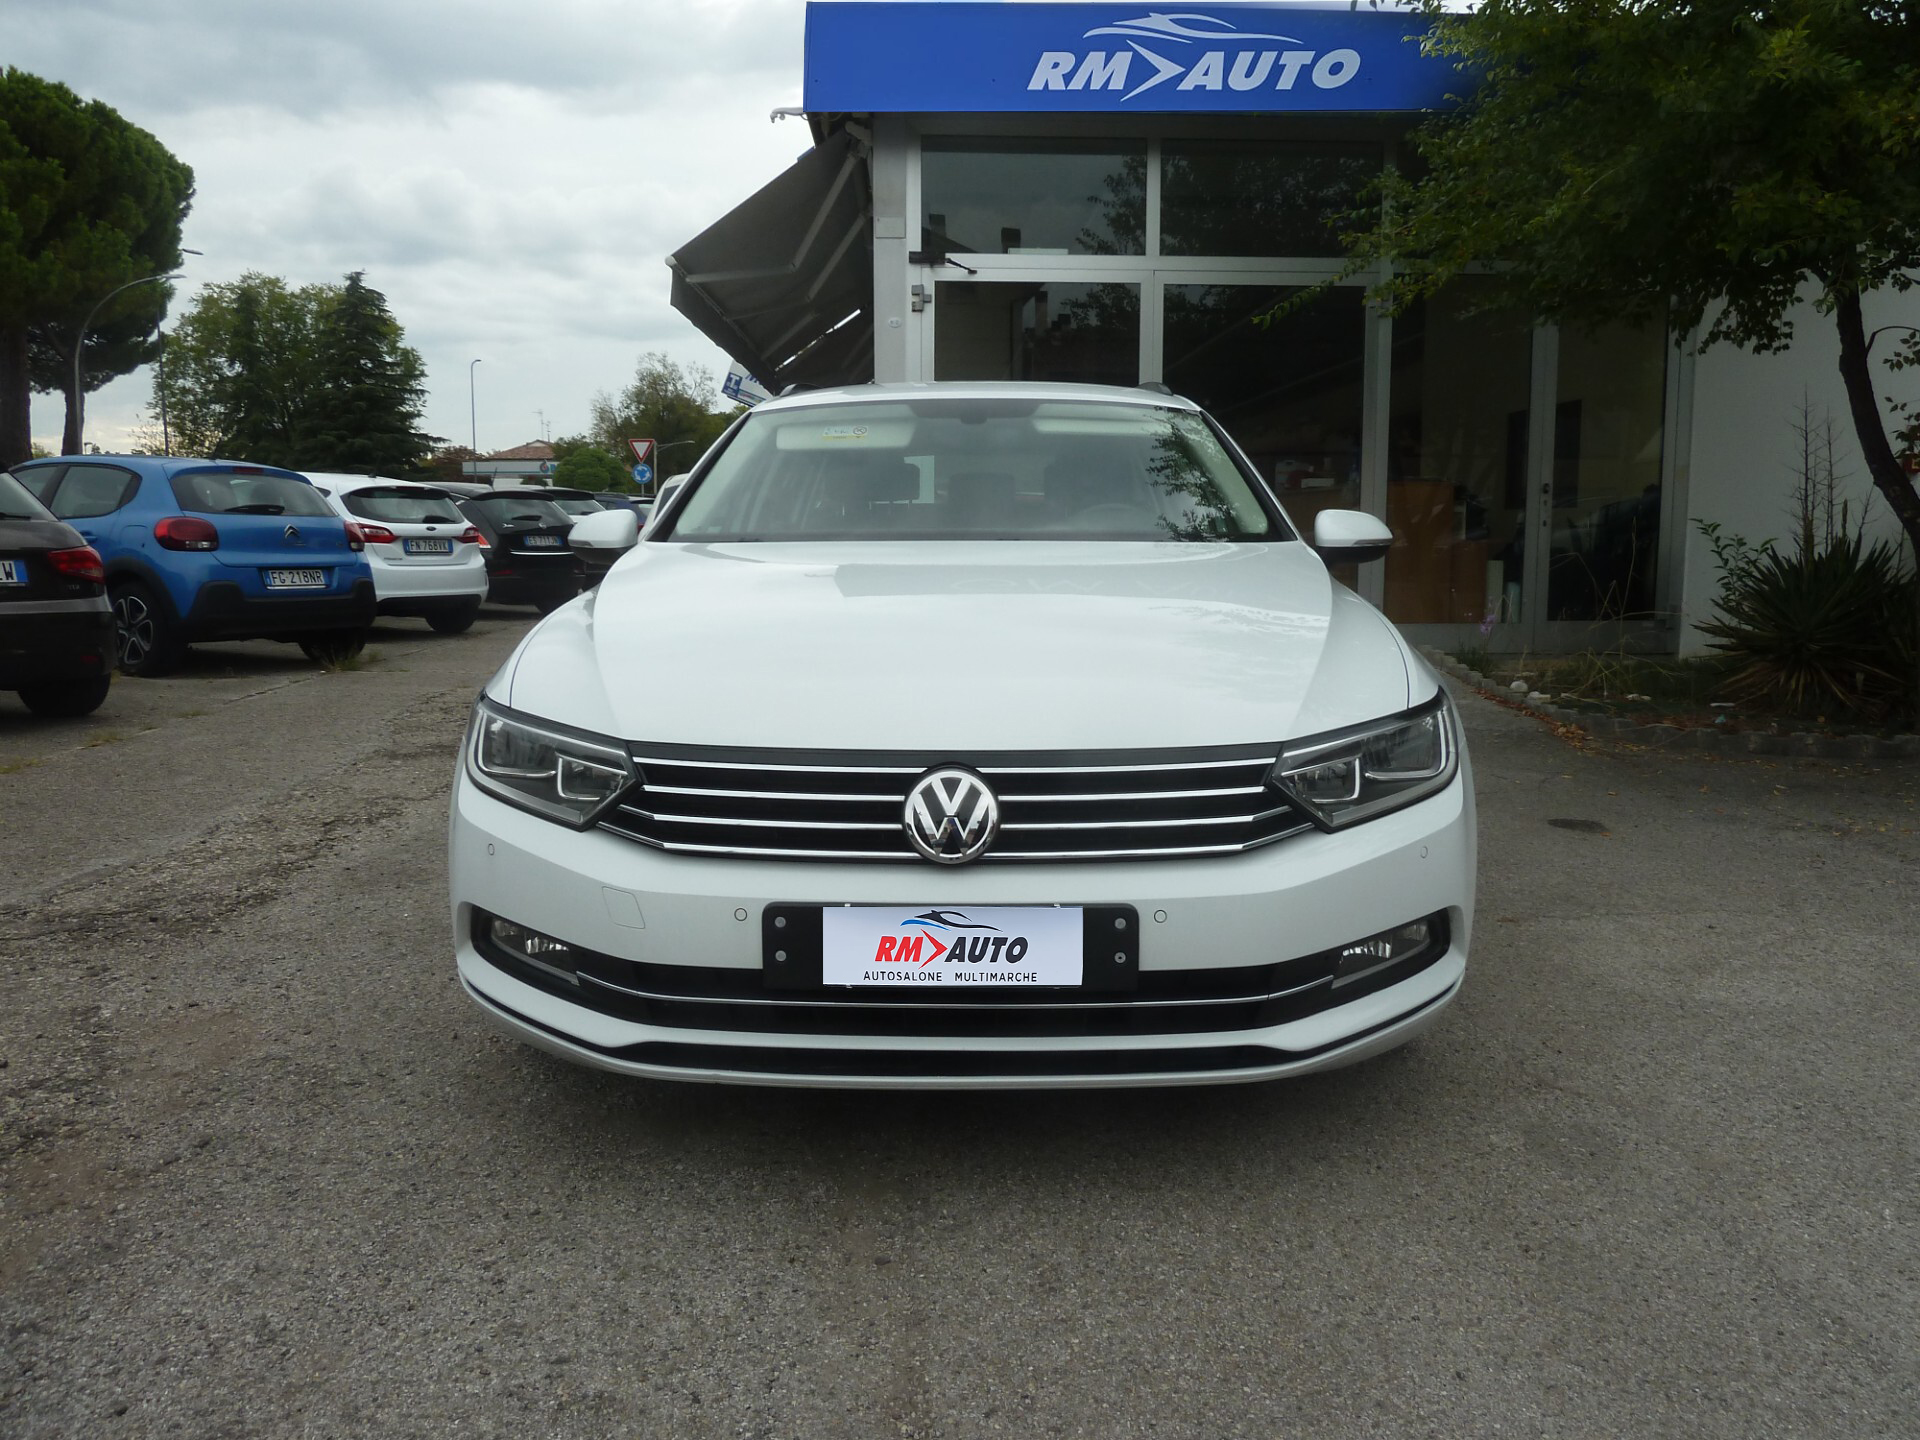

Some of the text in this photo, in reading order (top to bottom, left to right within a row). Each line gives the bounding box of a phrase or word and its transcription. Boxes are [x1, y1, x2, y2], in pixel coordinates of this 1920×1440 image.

[1176, 48, 1361, 91] AUTO
[0, 562, 14, 580] W
[944, 936, 1029, 964] AUTO
[863, 970, 1038, 982] AUTOSALONE MULTIMARCHE
